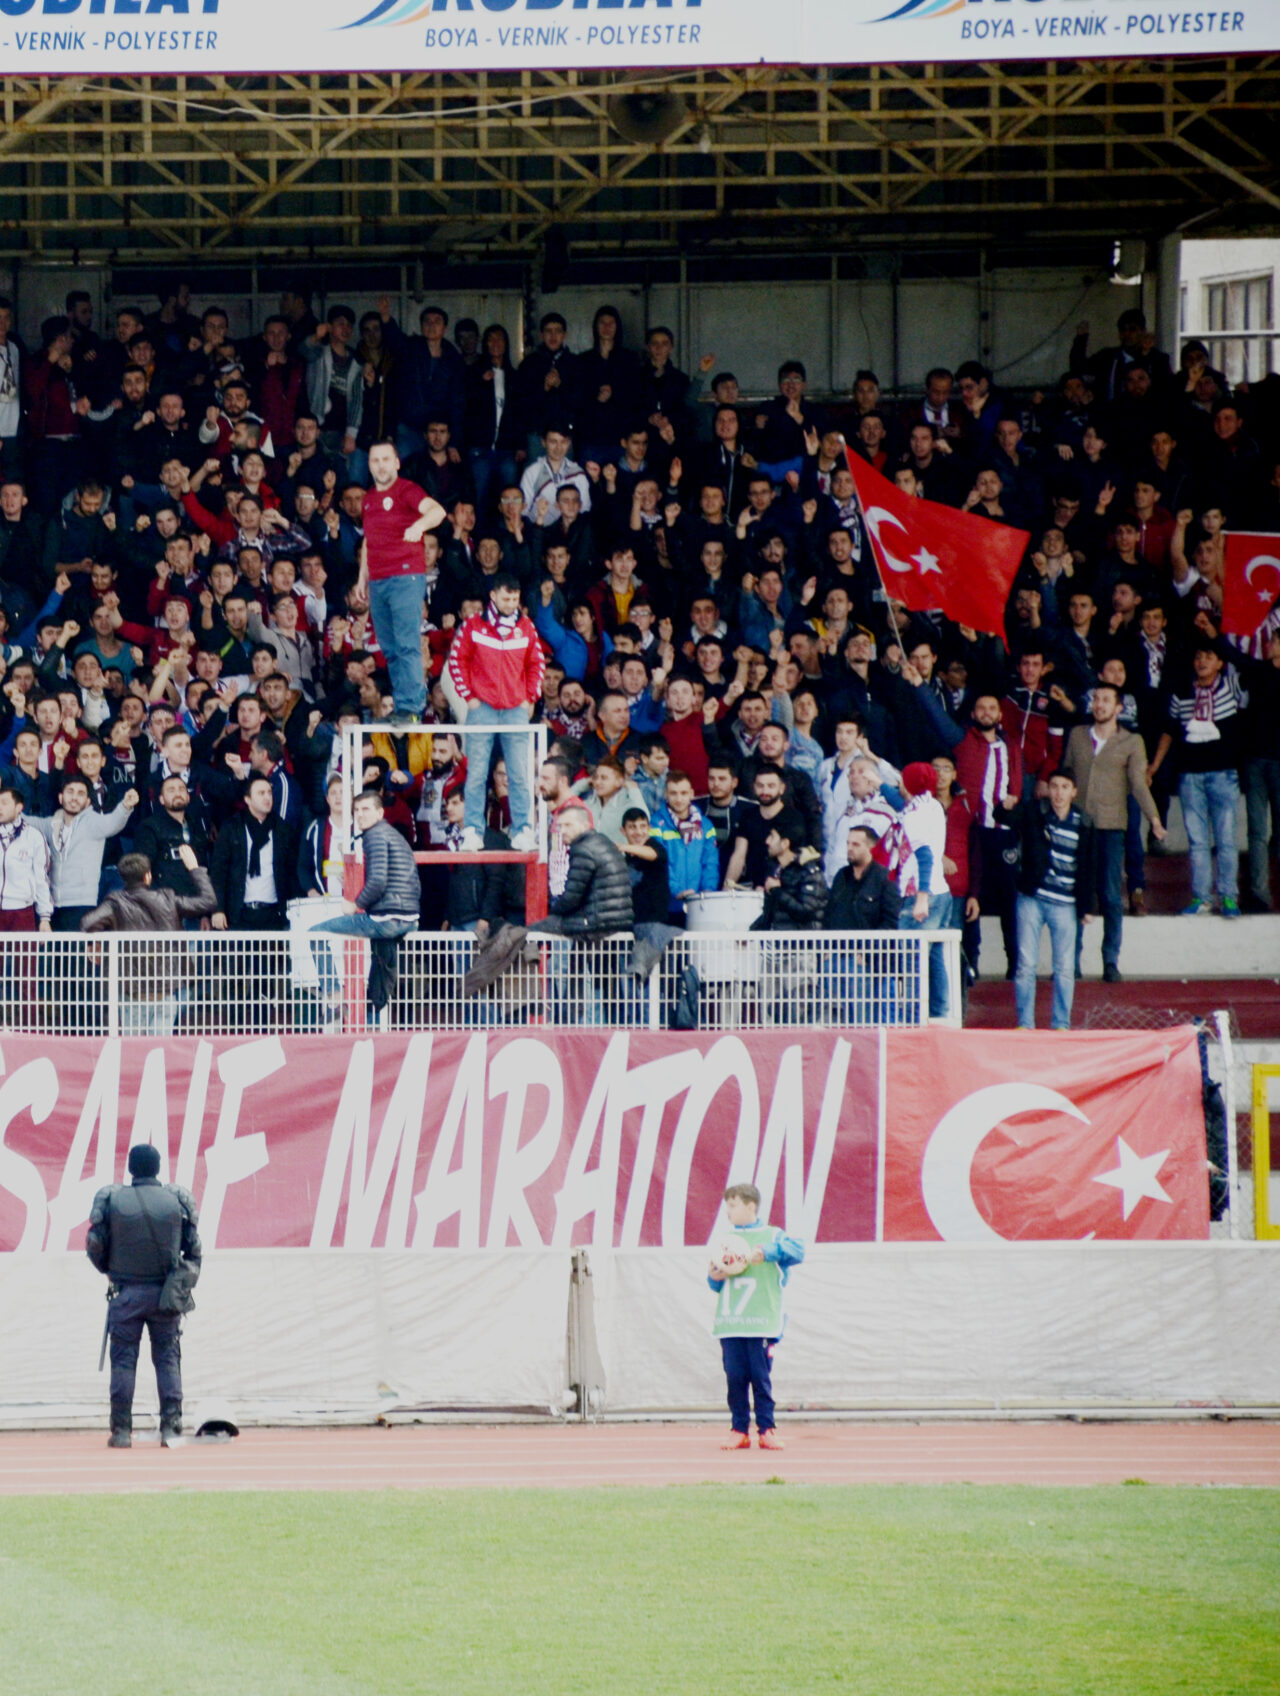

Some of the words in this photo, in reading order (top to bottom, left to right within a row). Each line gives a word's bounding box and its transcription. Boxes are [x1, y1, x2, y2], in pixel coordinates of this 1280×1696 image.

[15, 25, 86, 50] VERNİK
[104, 30, 217, 50] POLYESTER
[425, 28, 478, 47] BOYA
[498, 20, 568, 46] VERNİK
[587, 24, 701, 45] POLYESTER
[961, 19, 1015, 39] BOYA
[1035, 9, 1108, 36] VERNİK
[1126, 11, 1245, 35] POLYESTER
[310, 1031, 851, 1249] MARATON
[721, 1277, 757, 1316] 17
